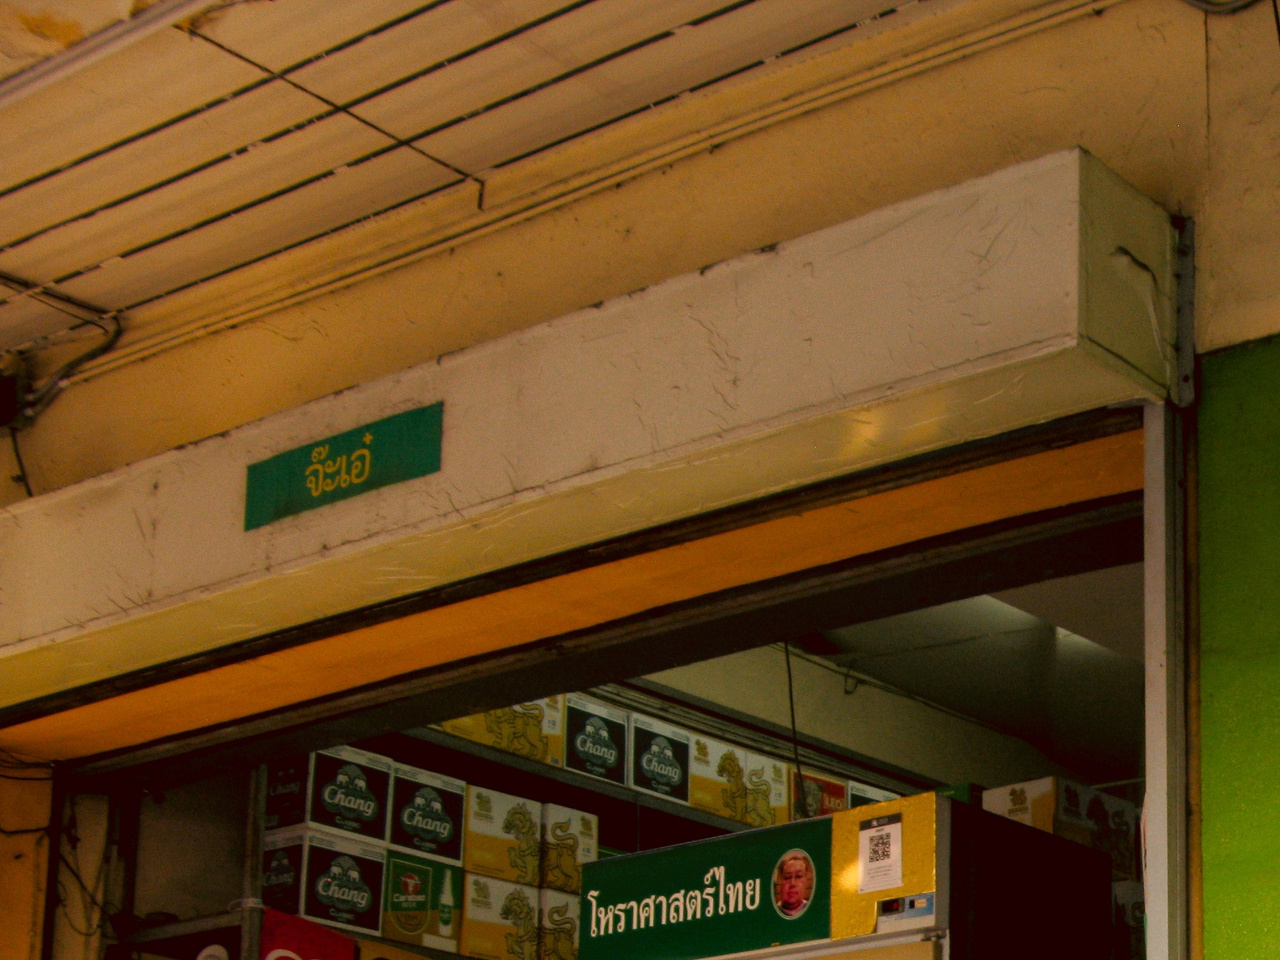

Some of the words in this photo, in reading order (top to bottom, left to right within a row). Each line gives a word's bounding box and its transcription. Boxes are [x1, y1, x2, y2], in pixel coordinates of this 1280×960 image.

[305, 432, 374, 497] จ๊ะเอ๋
[576, 735, 616, 763] Chang
[642, 755, 680, 781] Chang
[323, 785, 375, 817] Chang
[403, 807, 451, 838] Chang
[317, 877, 369, 907] Chang
[587, 866, 761, 937] โหราศาสตร์ไทย
